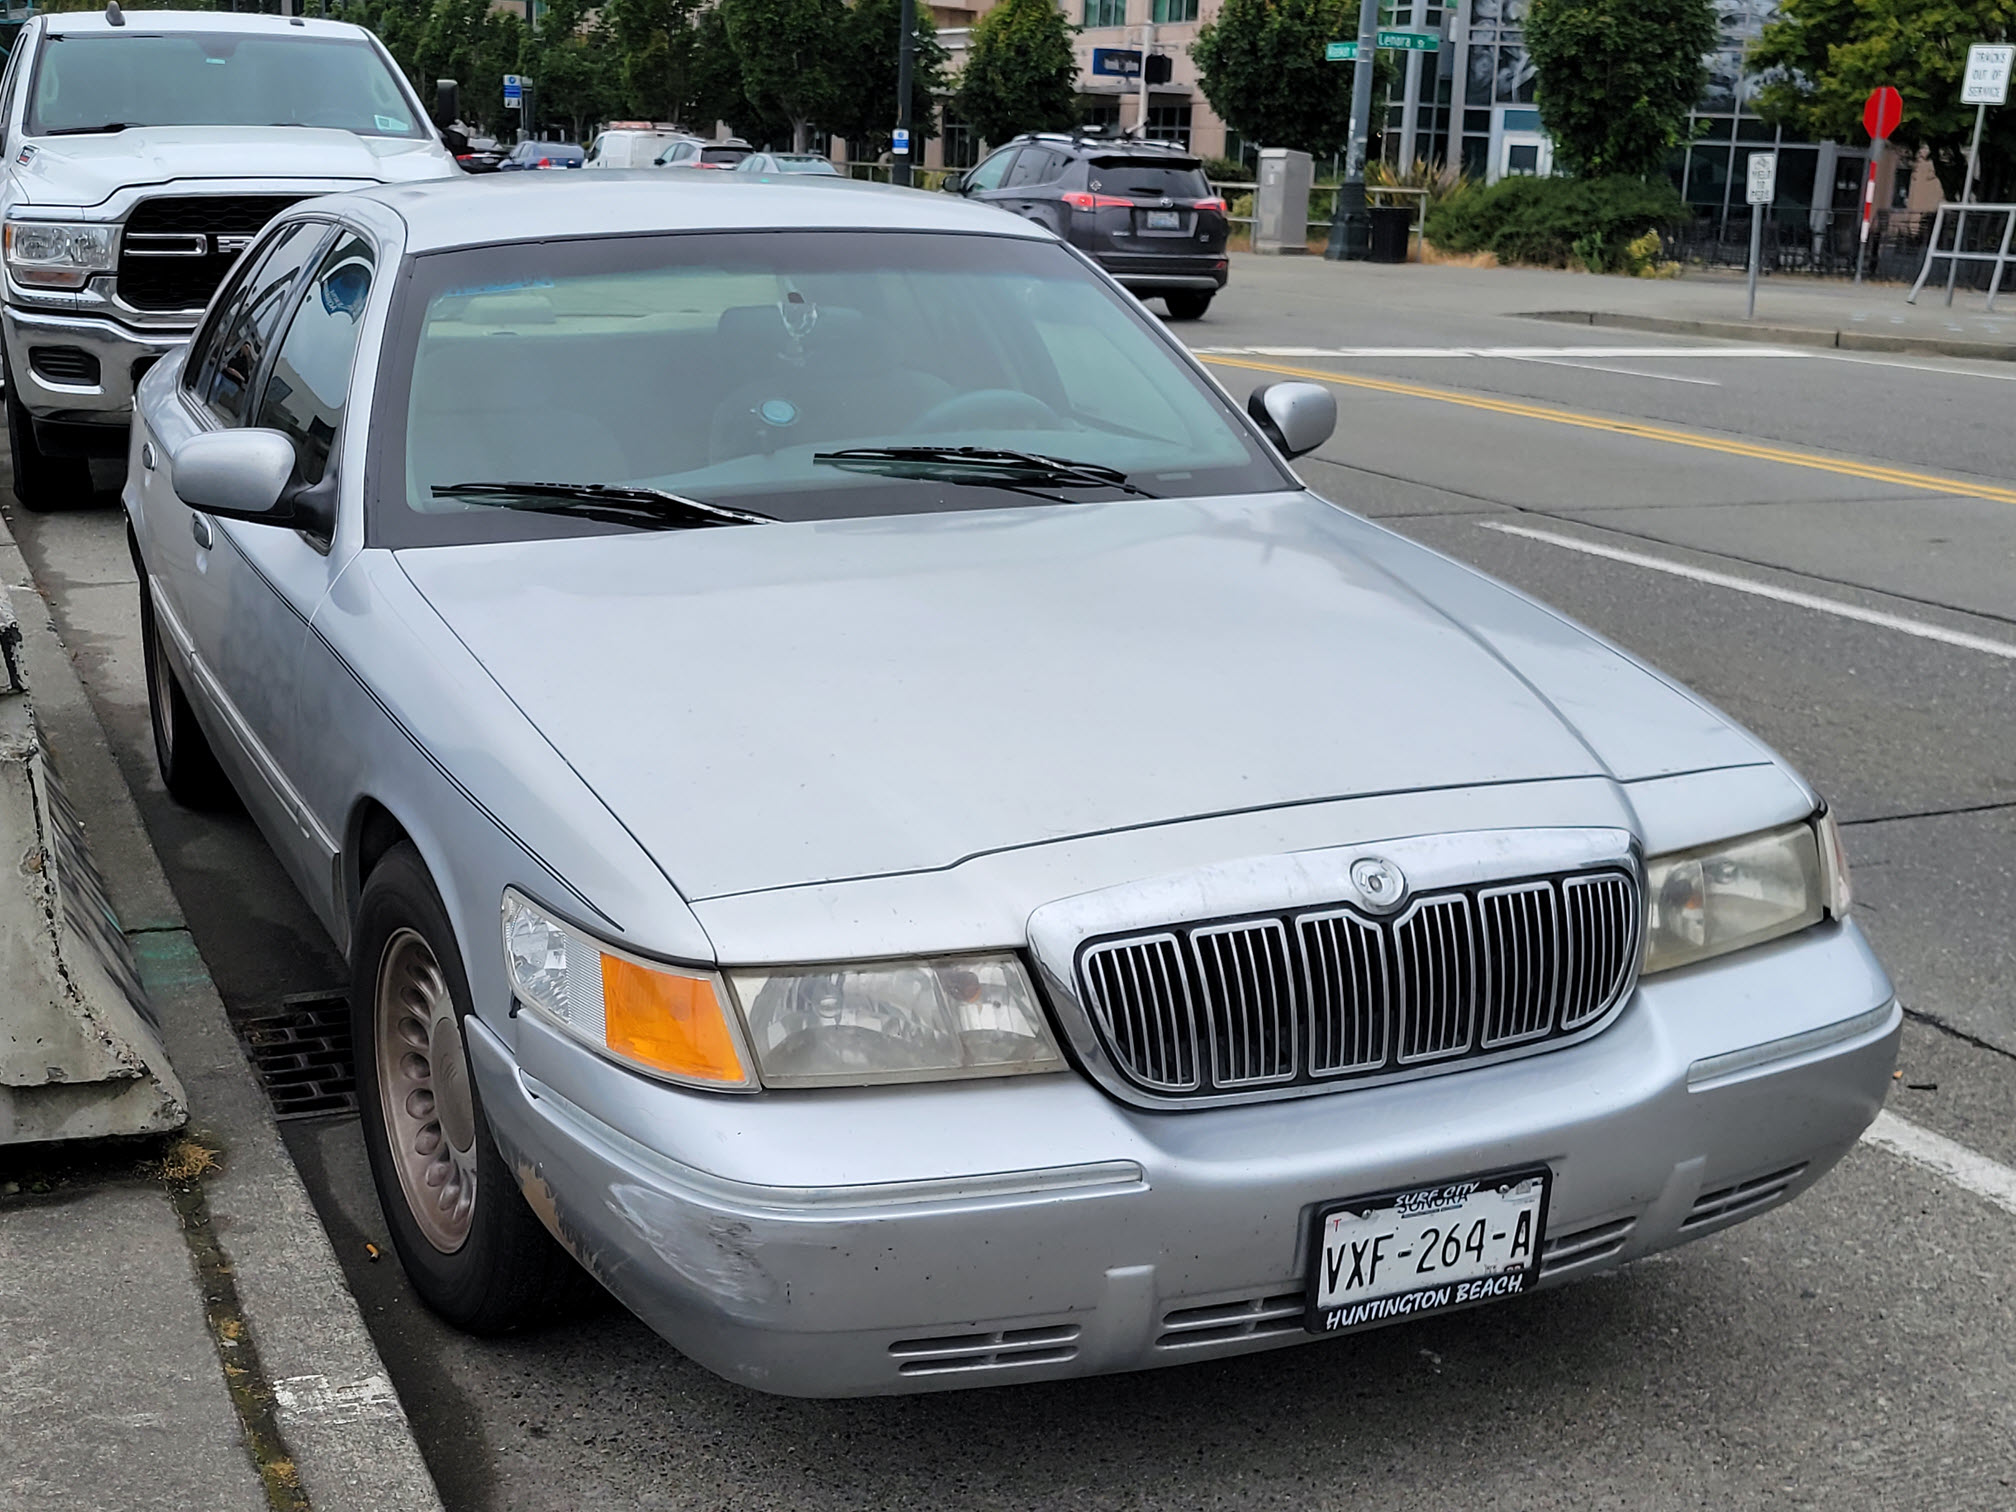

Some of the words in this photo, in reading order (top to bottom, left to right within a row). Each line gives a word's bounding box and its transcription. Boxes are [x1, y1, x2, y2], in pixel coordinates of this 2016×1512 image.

[1378, 32, 1411, 48] Lenora
[1972, 69, 1988, 80] OUT
[1992, 69, 2004, 80] OF
[1393, 1189, 1439, 1208] SURF
[1443, 1181, 1480, 1198] CITY
[1326, 1209, 1532, 1295] VXF-264-A
[1326, 1285, 1450, 1331] HUNTINGTON
